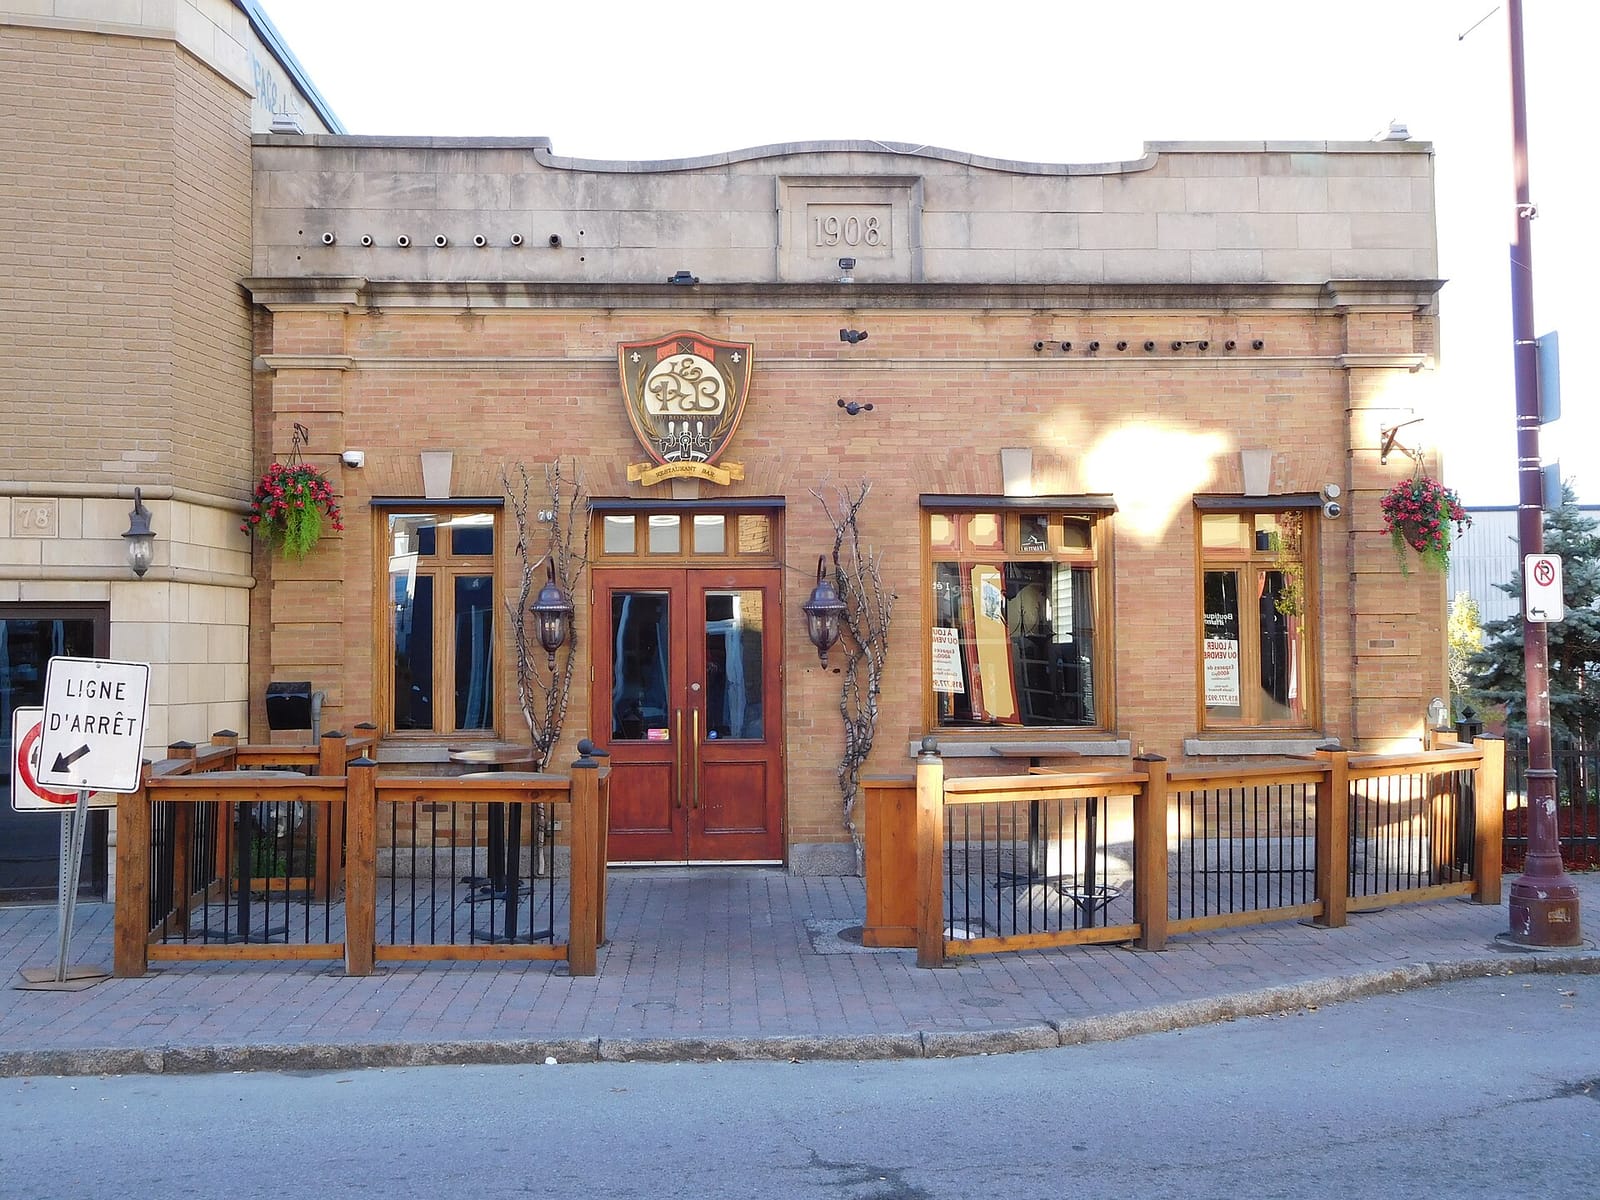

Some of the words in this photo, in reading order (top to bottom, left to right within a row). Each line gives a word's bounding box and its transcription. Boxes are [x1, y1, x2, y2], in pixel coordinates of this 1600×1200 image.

[655, 466, 696, 478] RESTAURANT
[701, 468, 716, 477] BAR
[66, 679, 126, 700] LIGNE
[50, 711, 137, 737] D'ARRÊT
